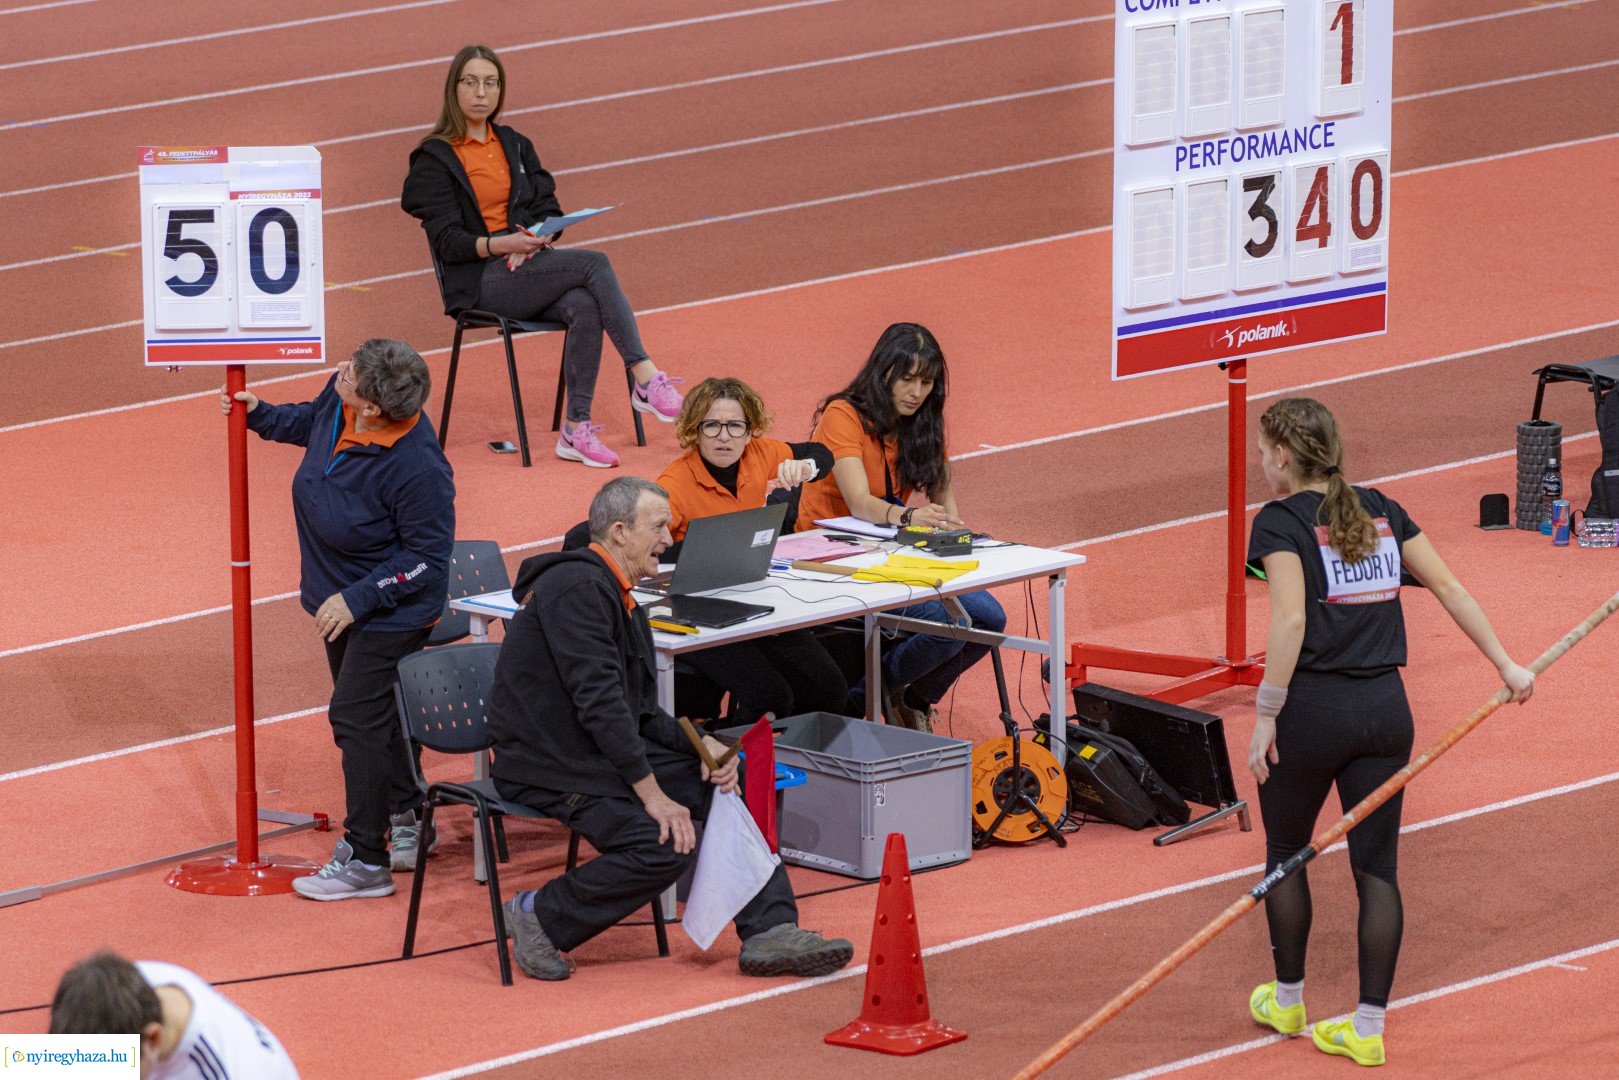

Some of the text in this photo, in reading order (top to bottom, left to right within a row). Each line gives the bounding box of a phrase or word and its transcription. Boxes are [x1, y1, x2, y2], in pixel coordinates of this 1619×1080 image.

[1329, 2, 1354, 85] 1
[1175, 121, 1335, 172] PERFORMANCE
[1237, 319, 1288, 349] polanik
[286, 347, 314, 355] polanik
[1332, 552, 1397, 585] FEDOR V.
